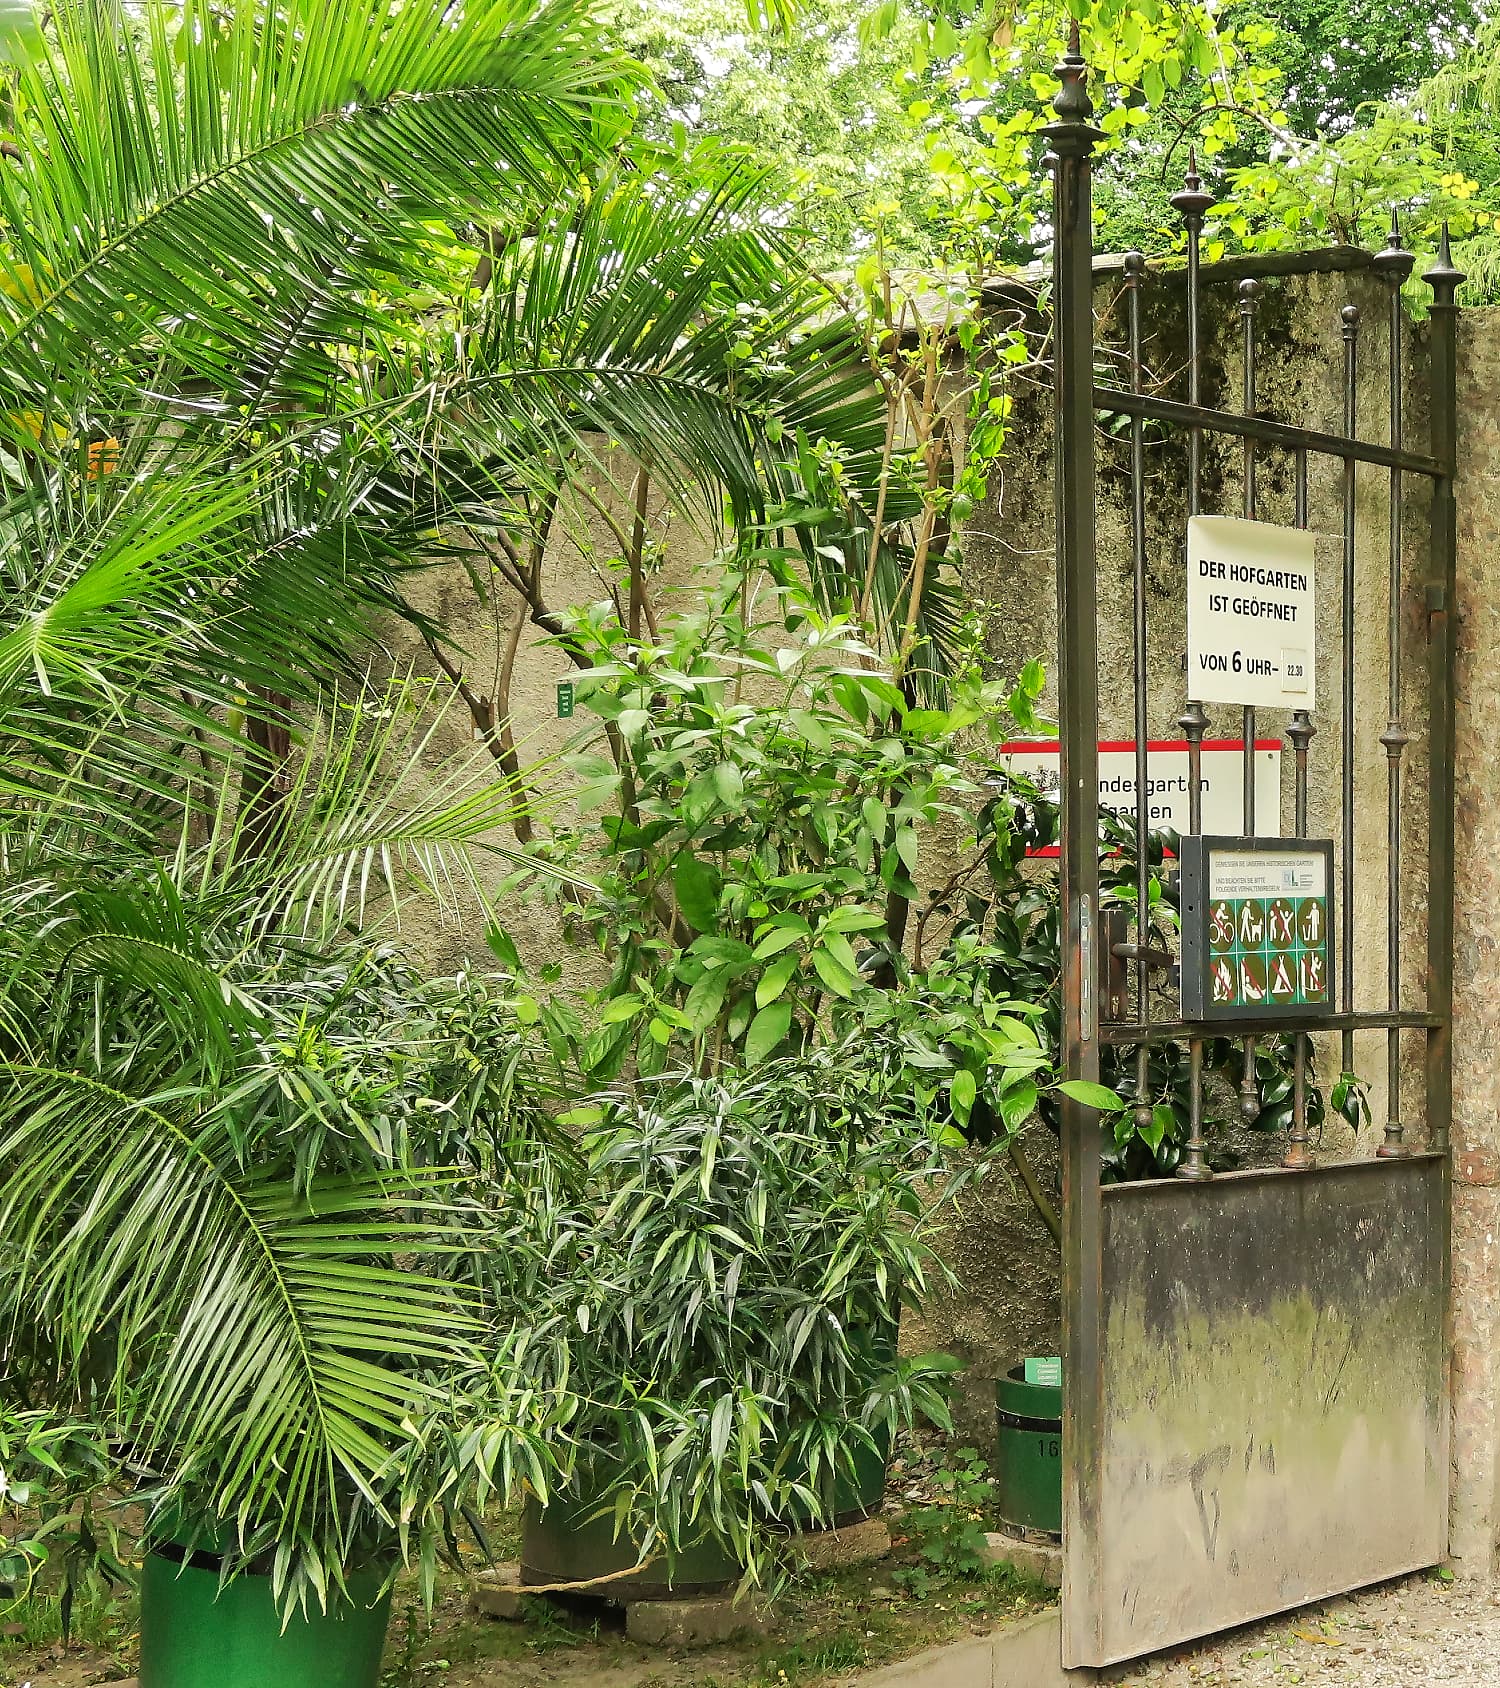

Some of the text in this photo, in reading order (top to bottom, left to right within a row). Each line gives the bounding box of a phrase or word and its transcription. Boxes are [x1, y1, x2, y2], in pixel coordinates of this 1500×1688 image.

[1199, 560, 1307, 591] DER HOFGARTEN
[1209, 594, 1298, 622] IST GEÖFFNET
[1199, 653, 1228, 672] VON
[1231, 650, 1242, 673] 6
[1287, 664, 1303, 677] 22.30
